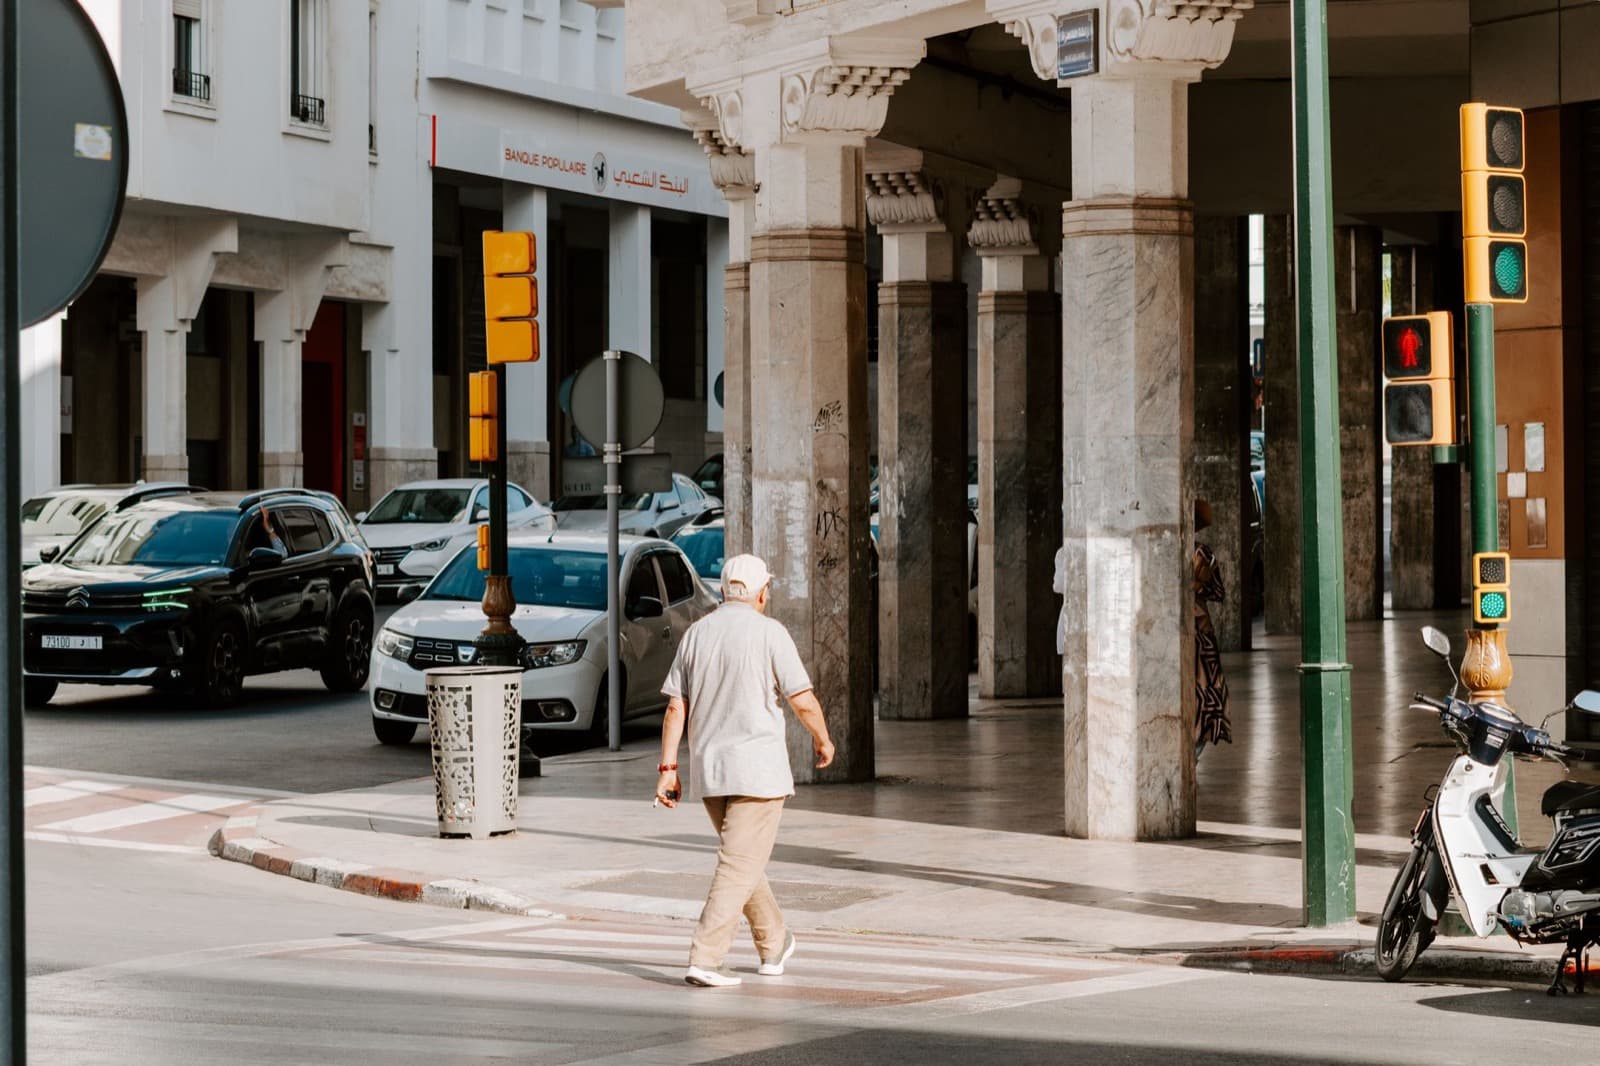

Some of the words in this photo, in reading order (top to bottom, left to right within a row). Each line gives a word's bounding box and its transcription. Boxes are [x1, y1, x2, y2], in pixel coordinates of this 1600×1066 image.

[505, 148, 540, 167] BANQUE
[541, 156, 587, 176] POPULAIRE
[613, 168, 657, 191] الشعبي
[659, 174, 689, 197] البنك
